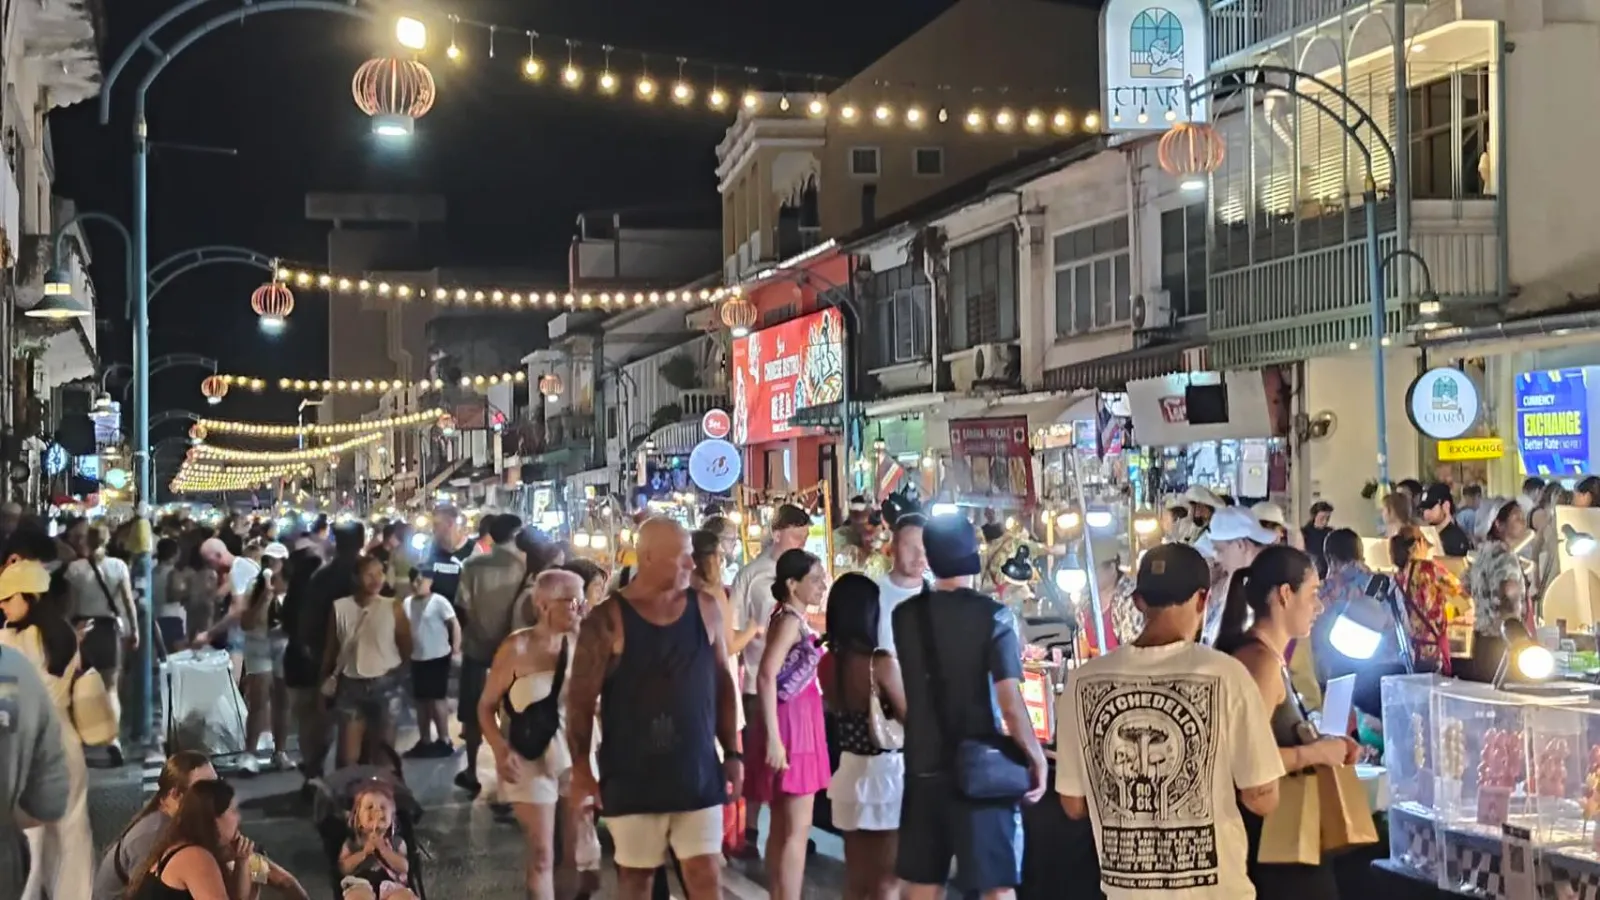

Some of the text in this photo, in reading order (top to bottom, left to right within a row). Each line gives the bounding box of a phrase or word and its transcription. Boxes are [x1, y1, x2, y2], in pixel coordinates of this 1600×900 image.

[1115, 86, 1199, 106] CHAR
[1523, 395, 1555, 407] CURRENCY
[1424, 410, 1466, 424] CHARM
[1524, 411, 1582, 437] EXCHANGE
[1449, 445, 1502, 454] EXCHANGE
[1524, 439, 1544, 451] Better
[1544, 437, 1559, 450] Rate
[1095, 693, 1199, 737] PSYCHEDELIC
